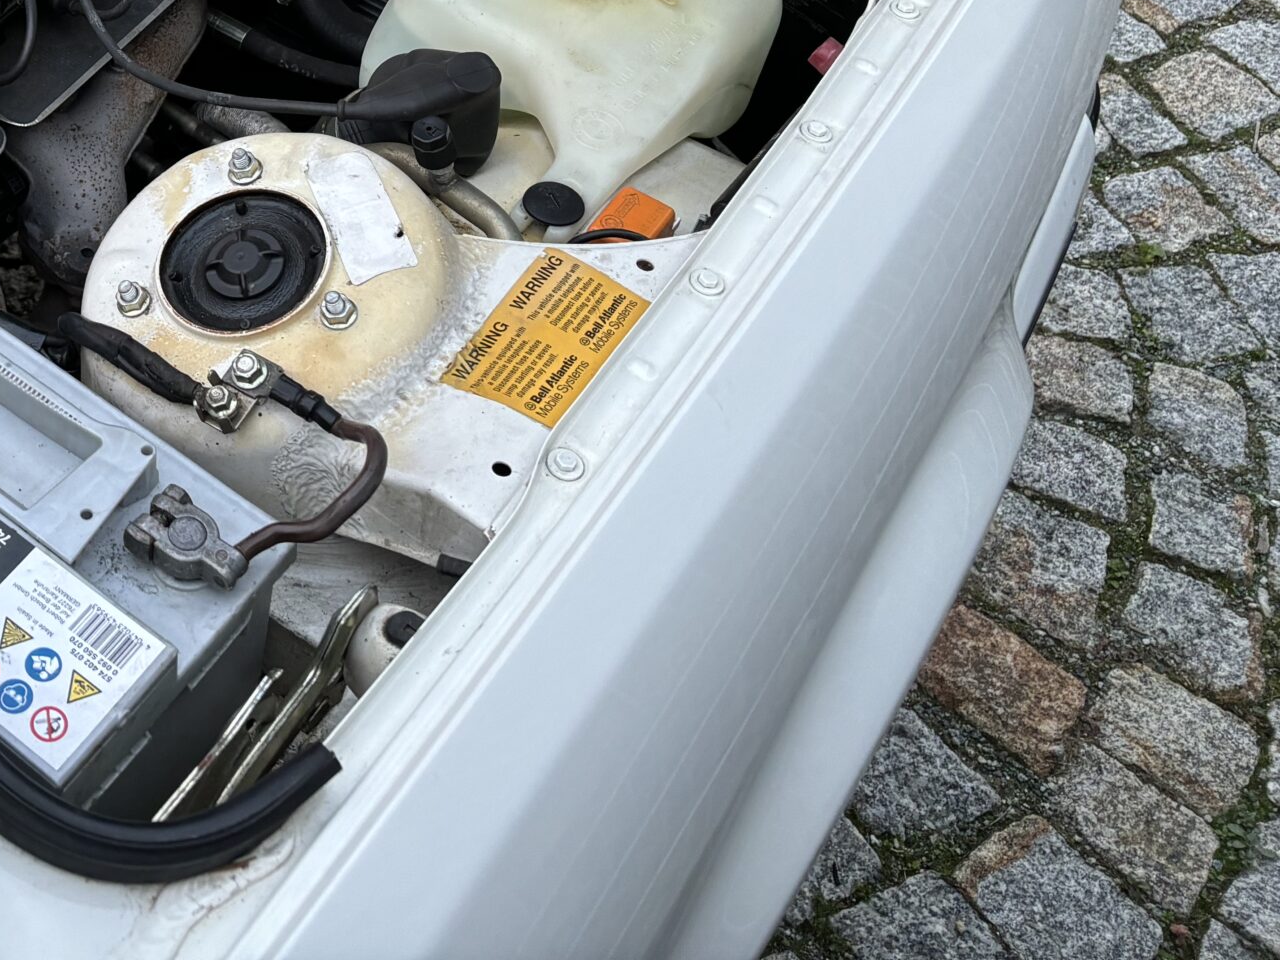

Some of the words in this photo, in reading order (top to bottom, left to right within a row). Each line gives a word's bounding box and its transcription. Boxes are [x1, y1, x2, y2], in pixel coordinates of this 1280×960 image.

[508, 255, 563, 309] WARNING
[526, 309, 540, 320] This
[536, 292, 555, 310] vehicle
[551, 271, 572, 294] equipped
[568, 263, 580, 273] with
[546, 297, 564, 314] mobile
[559, 275, 584, 299] telephone.
[548, 300, 575, 326] Disconnect
[570, 290, 583, 302] fuse
[578, 276, 595, 292] before
[559, 318, 574, 333] jump
[569, 301, 589, 320] starting
[584, 295, 591, 303] or
[588, 282, 603, 297] severe
[571, 314, 590, 333] damage
[586, 304, 599, 315] may
[584, 320, 604, 339] Bell
[598, 293, 626, 324] Atlantic
[588, 328, 615, 353] Mobile
[608, 299, 638, 330] Systems
[450, 321, 509, 379] WARNING
[480, 360, 499, 378] vehicle
[495, 336, 517, 360] equipped
[514, 326, 526, 338] with
[490, 363, 507, 381] mobile
[502, 339, 529, 368] telephone.
[492, 364, 520, 392] Disconnect
[514, 354, 529, 366] fuse
[524, 339, 542, 355] before
[502, 383, 518, 397] jump
[514, 364, 535, 384] starting
[529, 358, 538, 366] or
[534, 343, 552, 360] severe
[515, 378, 536, 398] damage
[532, 367, 546, 379] may
[541, 352, 557, 369] result.
[529, 384, 551, 404] Bell
[545, 354, 577, 388] Atlantic
[534, 392, 563, 418] Mobile
[555, 360, 589, 393] Systems
[29, 595, 47, 610] Bosch
[33, 579, 59, 600] Karlsruhe
[53, 584, 81, 607] GERMANY
[16, 606, 32, 621] Spain
[45, 607, 65, 624] Robert
[50, 602, 61, 610] der
[56, 598, 75, 613] 76227
[58, 607, 71, 618] Auf
[31, 617, 39, 625] in
[38, 623, 54, 637] Made
[68, 635, 83, 648] 070
[69, 647, 84, 661] 075
[83, 658, 98, 671] 402
[97, 657, 112, 671] 092
[97, 669, 112, 682] 574
[111, 668, 118, 676] 0
